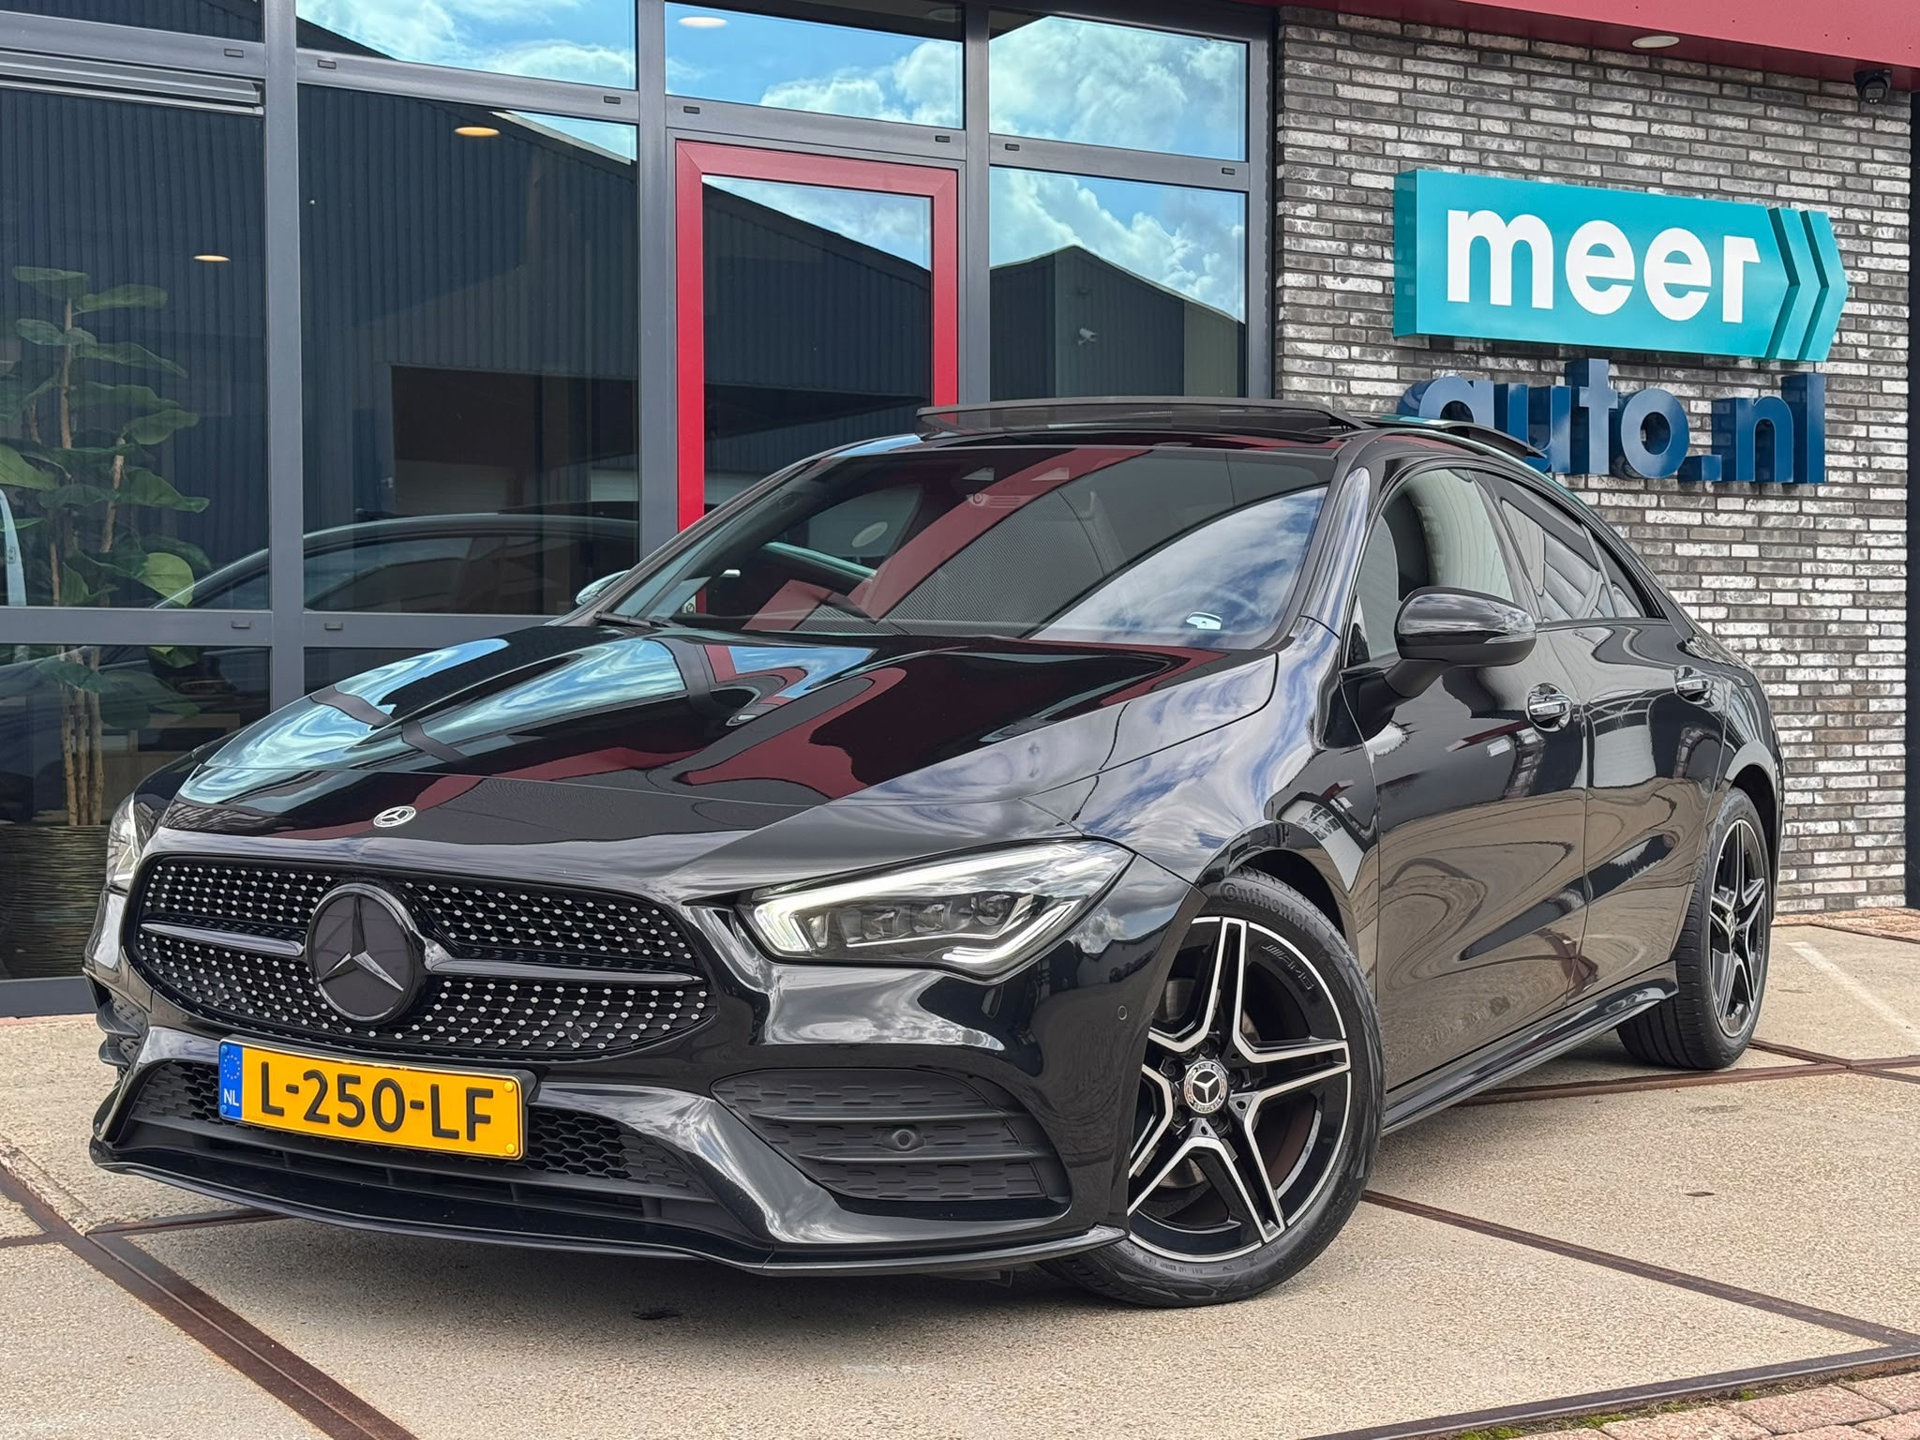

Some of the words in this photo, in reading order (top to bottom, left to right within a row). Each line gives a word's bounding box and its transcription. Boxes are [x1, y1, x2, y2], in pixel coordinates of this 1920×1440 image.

[1447, 209, 1761, 323] meer
[1408, 358, 1826, 484] auto.nl
[223, 1088, 240, 1107] NL
[261, 1061, 494, 1142] L-250-LF
